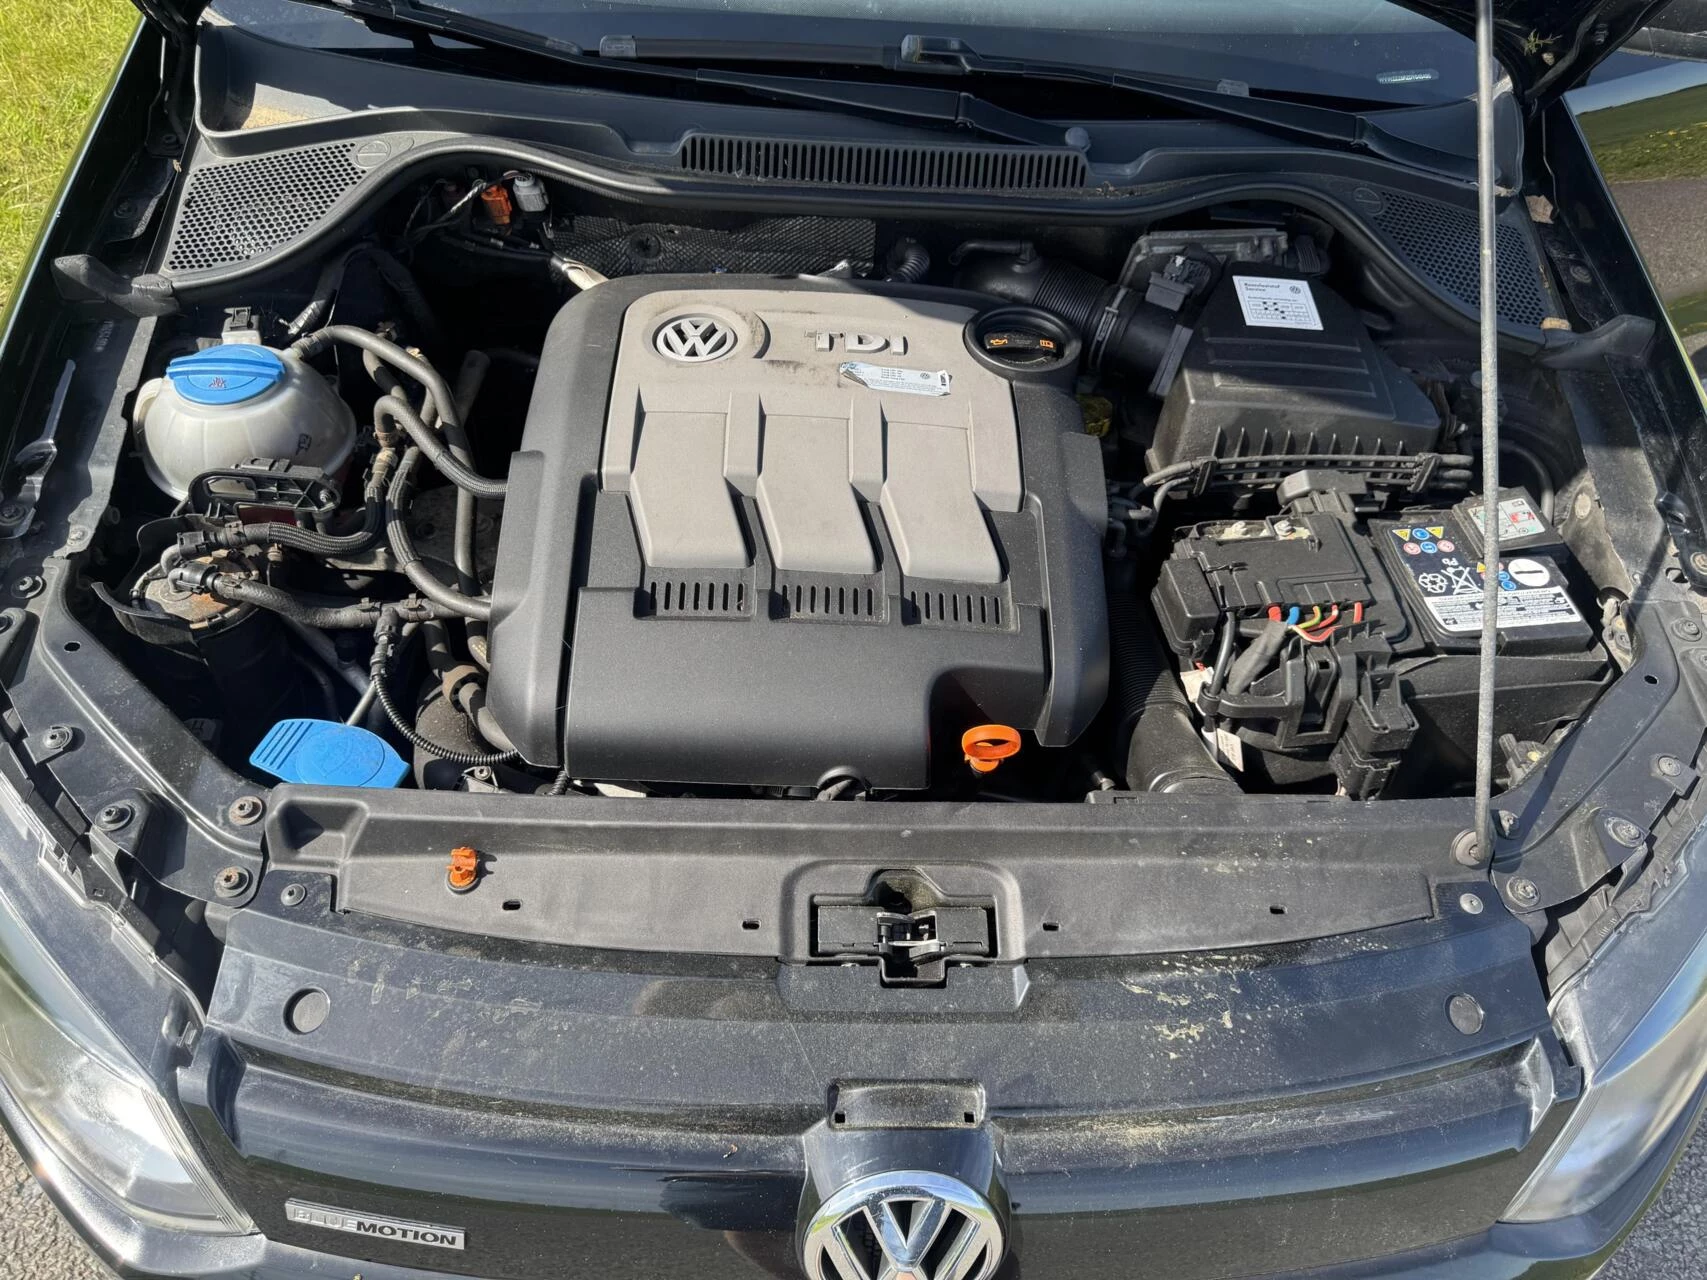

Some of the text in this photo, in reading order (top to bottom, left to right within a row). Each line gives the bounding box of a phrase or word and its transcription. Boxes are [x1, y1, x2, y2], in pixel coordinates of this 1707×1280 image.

[656, 317, 735, 361] VW
[804, 331, 904, 355] TDI
[294, 1208, 457, 1247] BLUEMOTION
